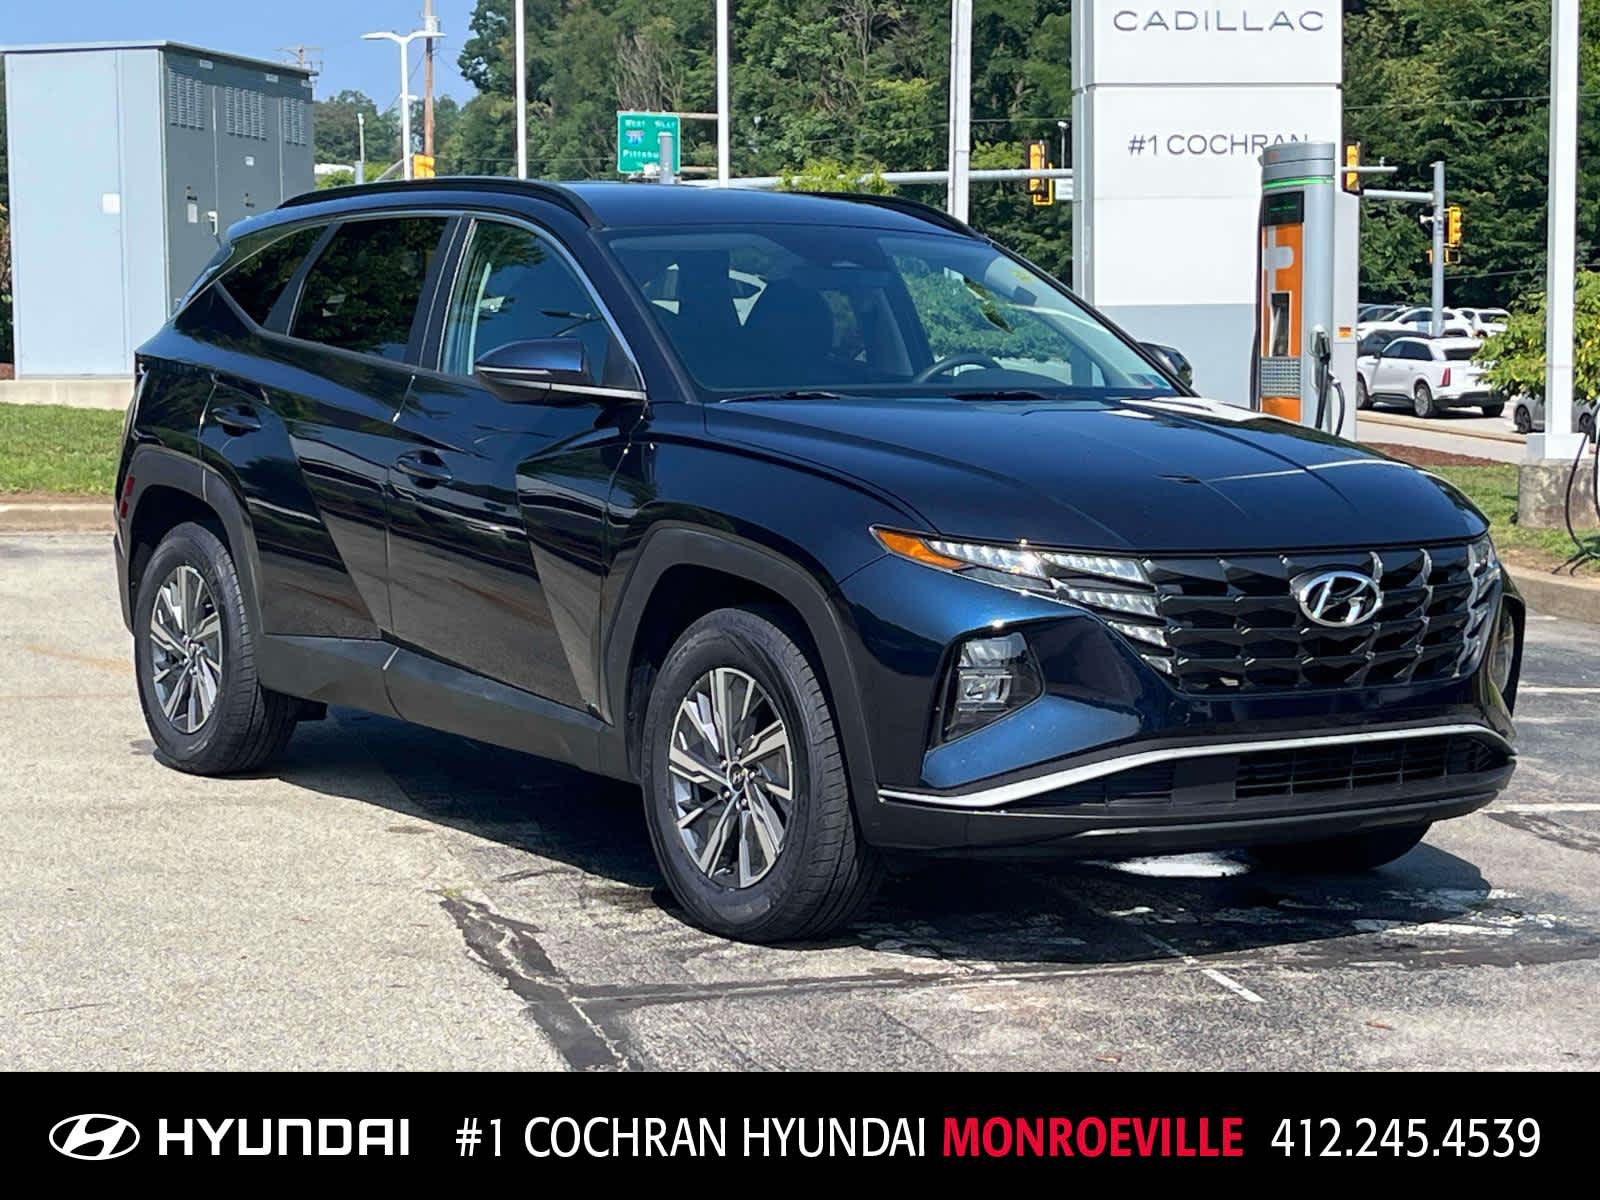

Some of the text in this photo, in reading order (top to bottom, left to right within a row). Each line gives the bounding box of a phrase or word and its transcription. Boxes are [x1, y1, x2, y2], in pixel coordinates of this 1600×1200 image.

[1113, 10, 1324, 31] CADILLAC
[622, 149, 660, 159] Pittsbu
[1127, 134, 1158, 156] #1
